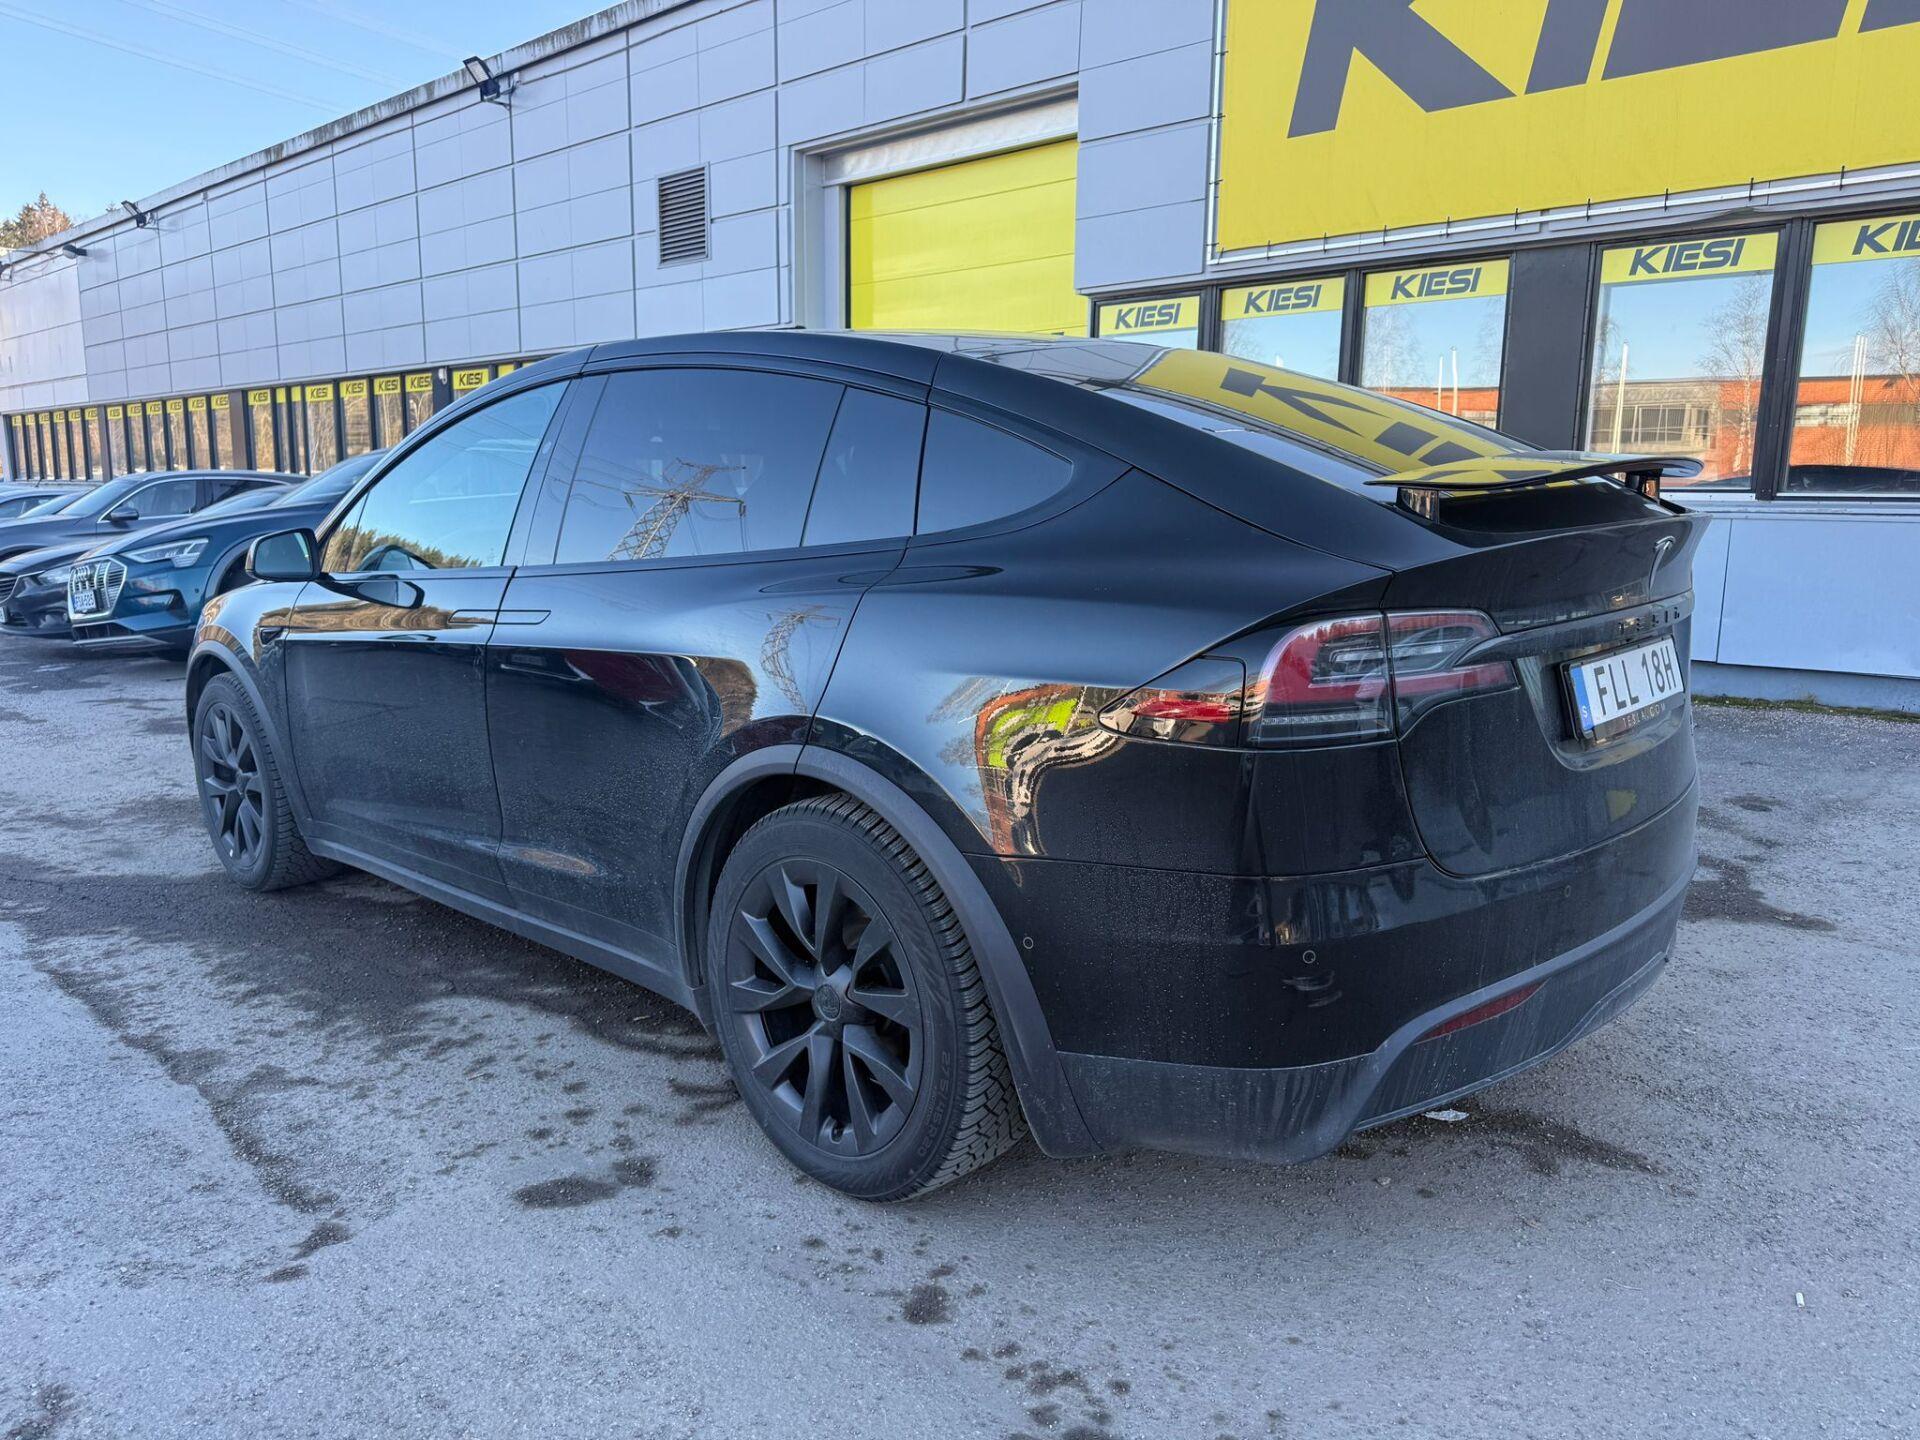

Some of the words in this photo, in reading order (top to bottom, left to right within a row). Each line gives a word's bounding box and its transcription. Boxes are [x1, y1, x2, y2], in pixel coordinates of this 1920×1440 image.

[1628, 238, 1746, 276] KIESI
[1391, 267, 1482, 300] KIESI
[1243, 284, 1322, 314] KIESI
[1115, 302, 1182, 330] KIESI
[410, 375, 432, 389] KIES
[459, 372, 483, 387] KIESI
[1593, 659, 1640, 716] FLL
[1641, 645, 1677, 698] 18H
